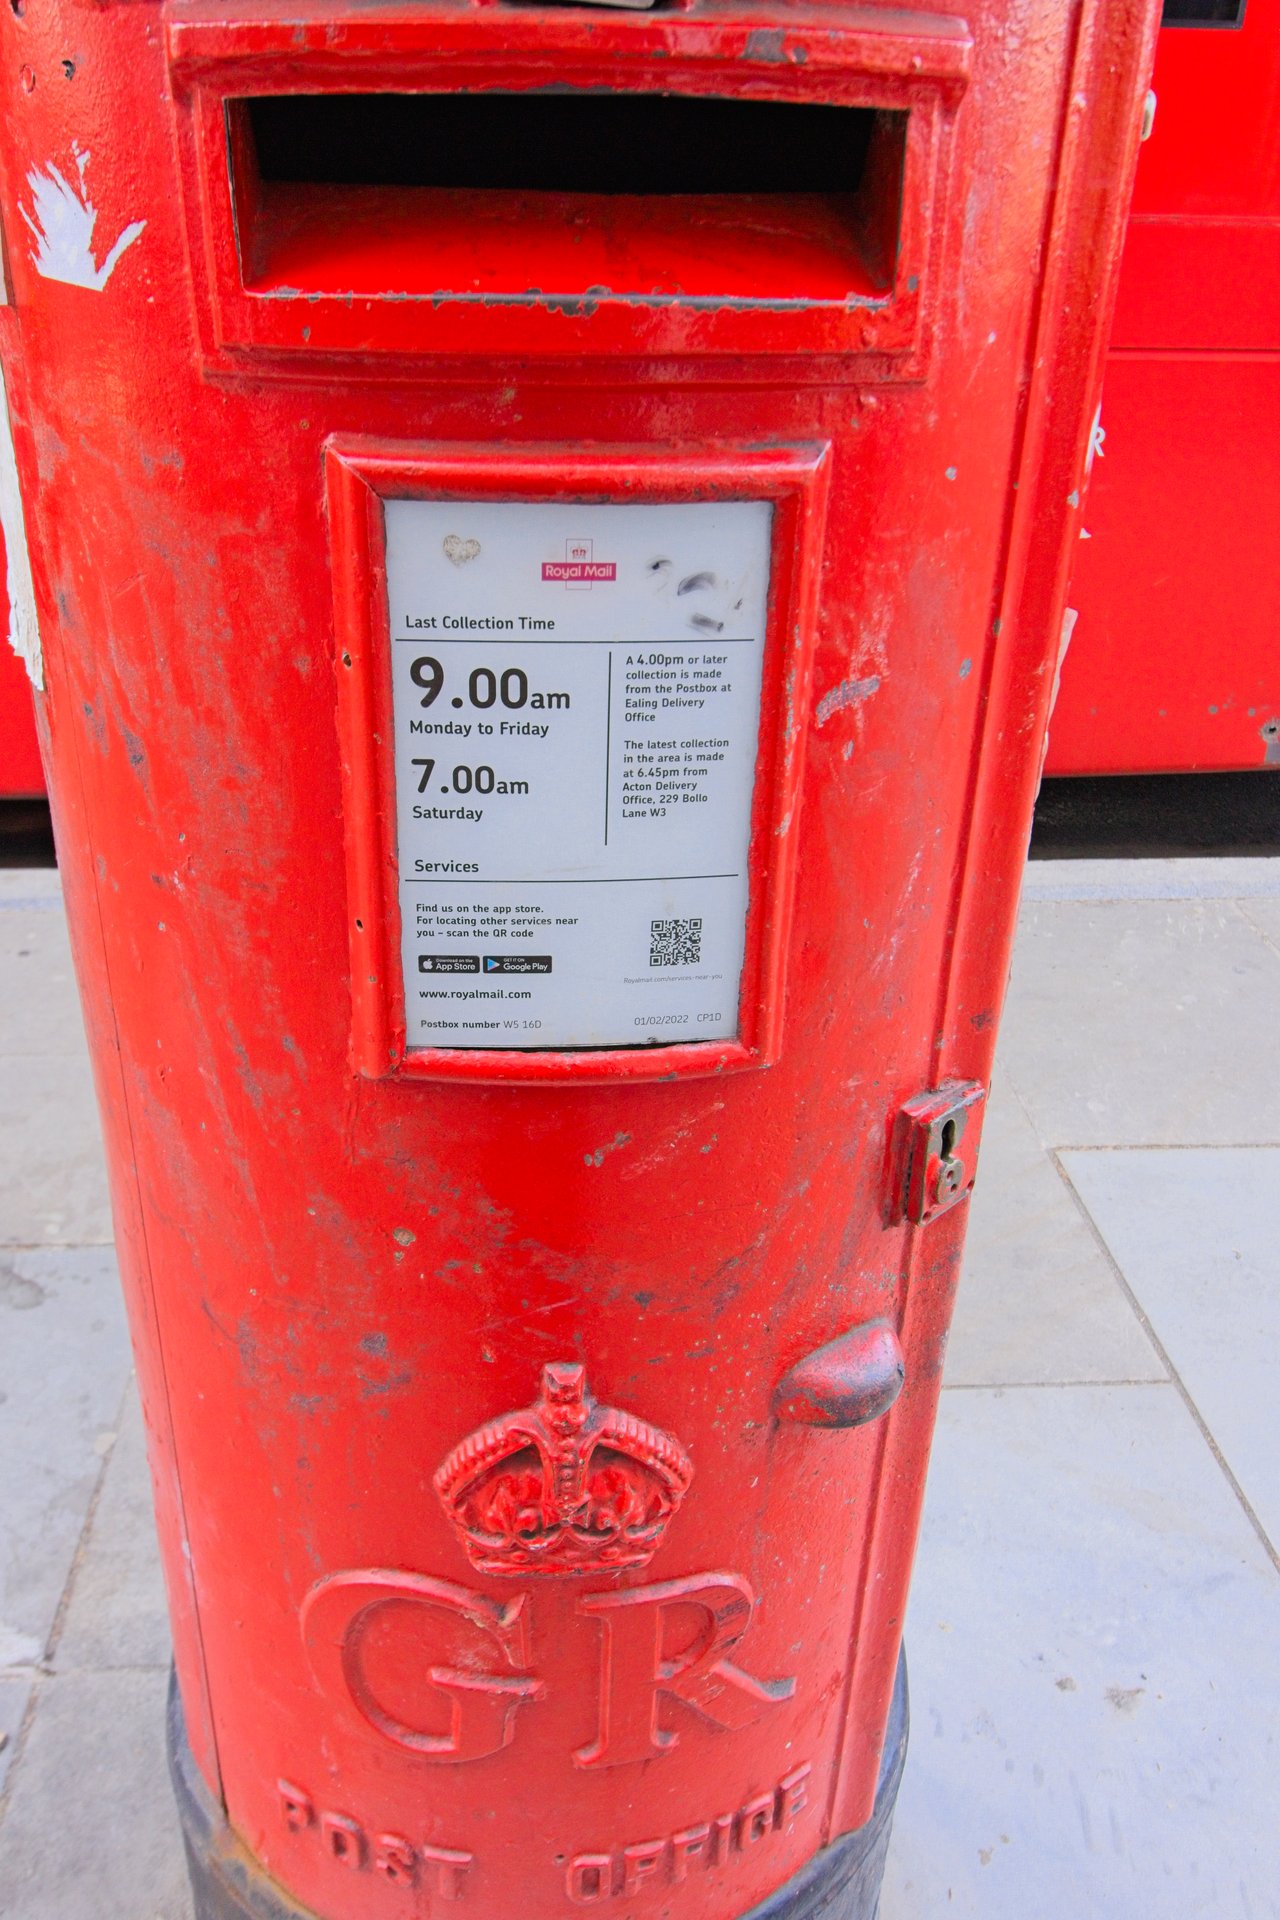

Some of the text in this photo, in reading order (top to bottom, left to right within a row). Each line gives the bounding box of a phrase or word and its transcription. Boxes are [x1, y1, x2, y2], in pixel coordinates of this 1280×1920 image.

[545, 565, 613, 579] Royal Mail
[405, 615, 556, 630] Last Collection Time
[626, 653, 728, 667] A 4.00pm or later
[626, 669, 722, 680] collection is made
[409, 656, 571, 709] 9.00am
[625, 683, 732, 694] from the Postbox at
[625, 698, 705, 709] Ealing Delivery
[625, 712, 656, 722] Office
[409, 720, 550, 739] Monday to Friday
[624, 738, 730, 750] The latest collection
[623, 754, 633, 763] in
[637, 754, 654, 763] the
[684, 753, 693, 762] is
[696, 752, 725, 762] made
[411, 758, 529, 795] 7.00am
[623, 767, 708, 779] at 6.45pm from
[622, 781, 698, 792] Acton Delivery
[622, 794, 708, 805] Office, 229 Bollo
[412, 805, 483, 822] Saturday
[622, 808, 667, 818] Lane W3
[414, 859, 480, 874] Services
[416, 903, 544, 915] Find us on the app store.
[416, 916, 579, 927] For locating other services near
[416, 929, 435, 938] you
[446, 929, 469, 937] scan
[473, 929, 489, 937] the
[493, 929, 507, 938] QR
[511, 929, 534, 938] code
[436, 963, 476, 972] App Store
[503, 963, 548, 972] Google Play
[419, 990, 532, 1001] www.royalmail.com
[420, 1020, 542, 1029] Postbox number W5 16D
[634, 1012, 722, 1026] 01/02/2022 CP1D
[275, 1761, 812, 1903] POST OFFICE
